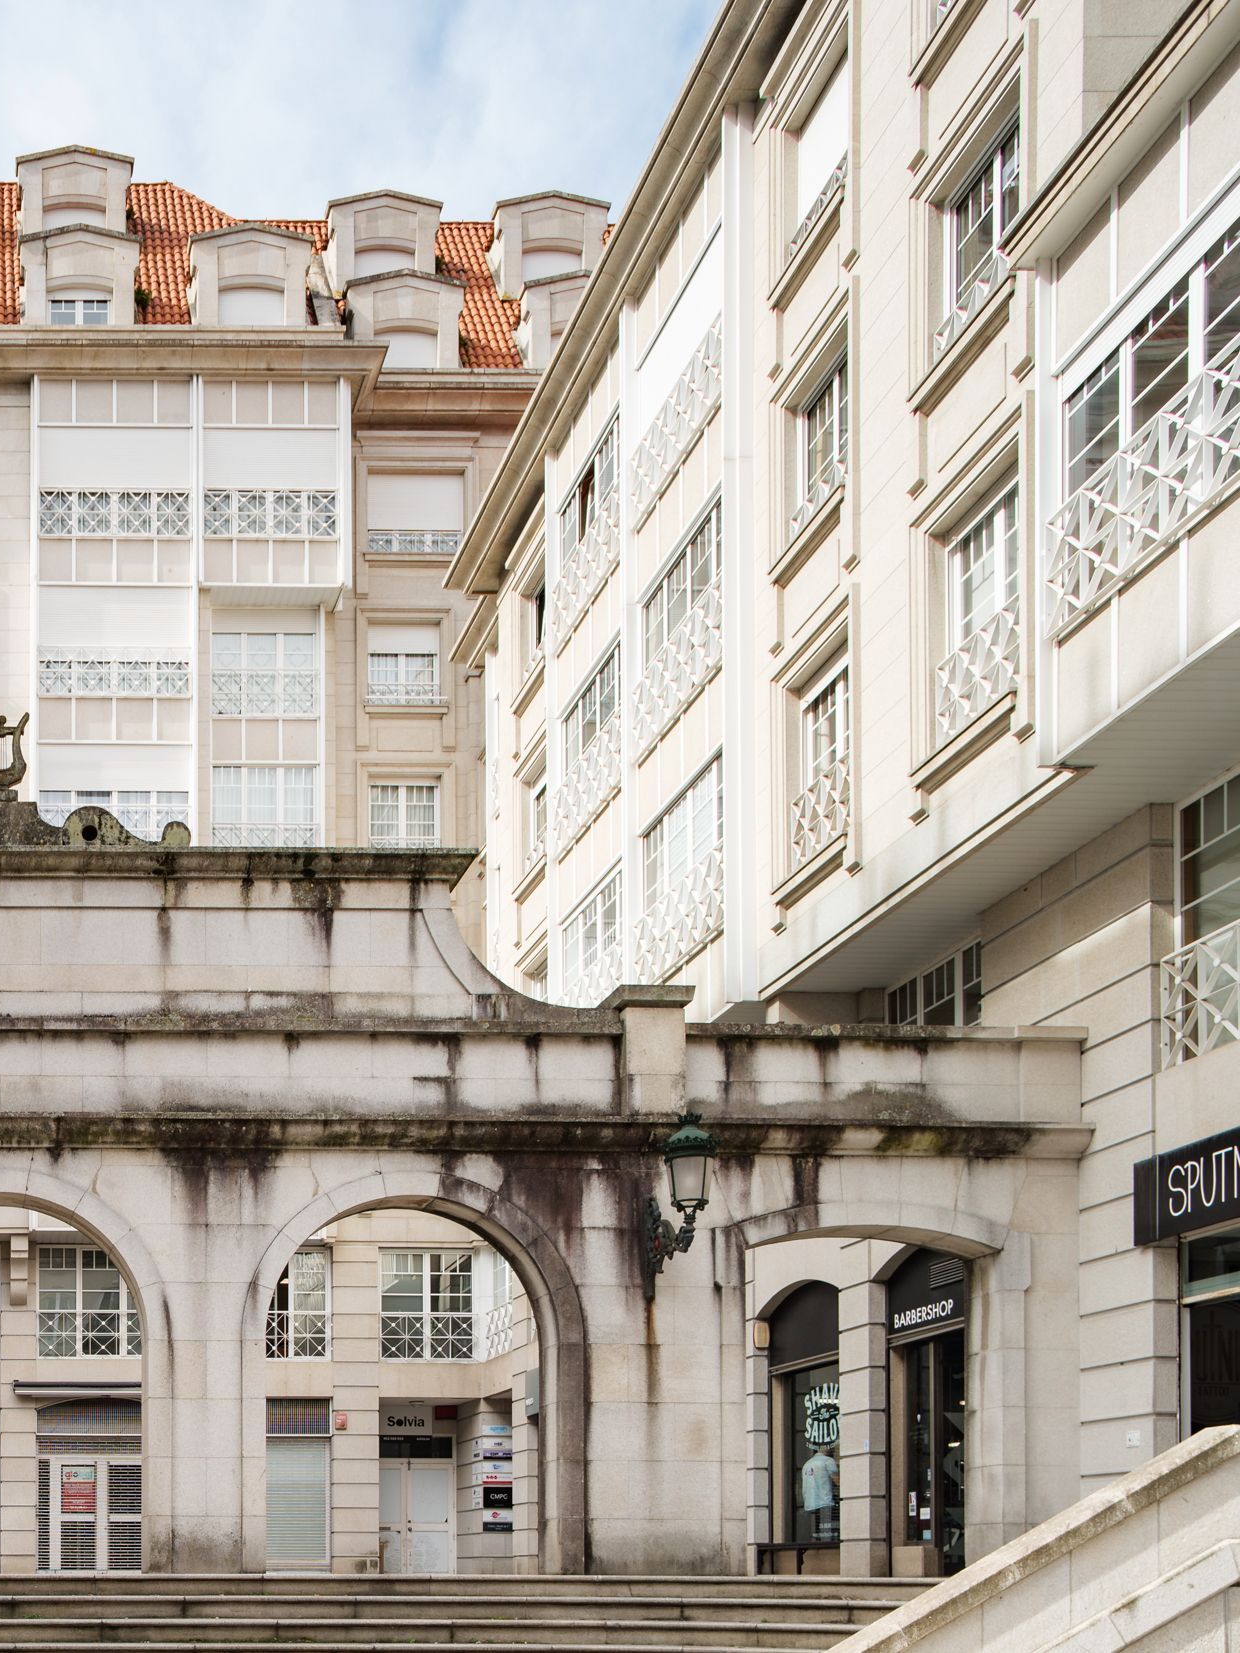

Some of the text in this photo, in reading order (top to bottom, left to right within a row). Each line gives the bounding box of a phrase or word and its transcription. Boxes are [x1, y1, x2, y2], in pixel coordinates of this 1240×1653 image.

[894, 1299, 954, 1328] BARBERSHOP
[804, 1383, 839, 1415] SHAV
[387, 1415, 425, 1427] Solvia
[804, 1417, 839, 1442] SAILO
